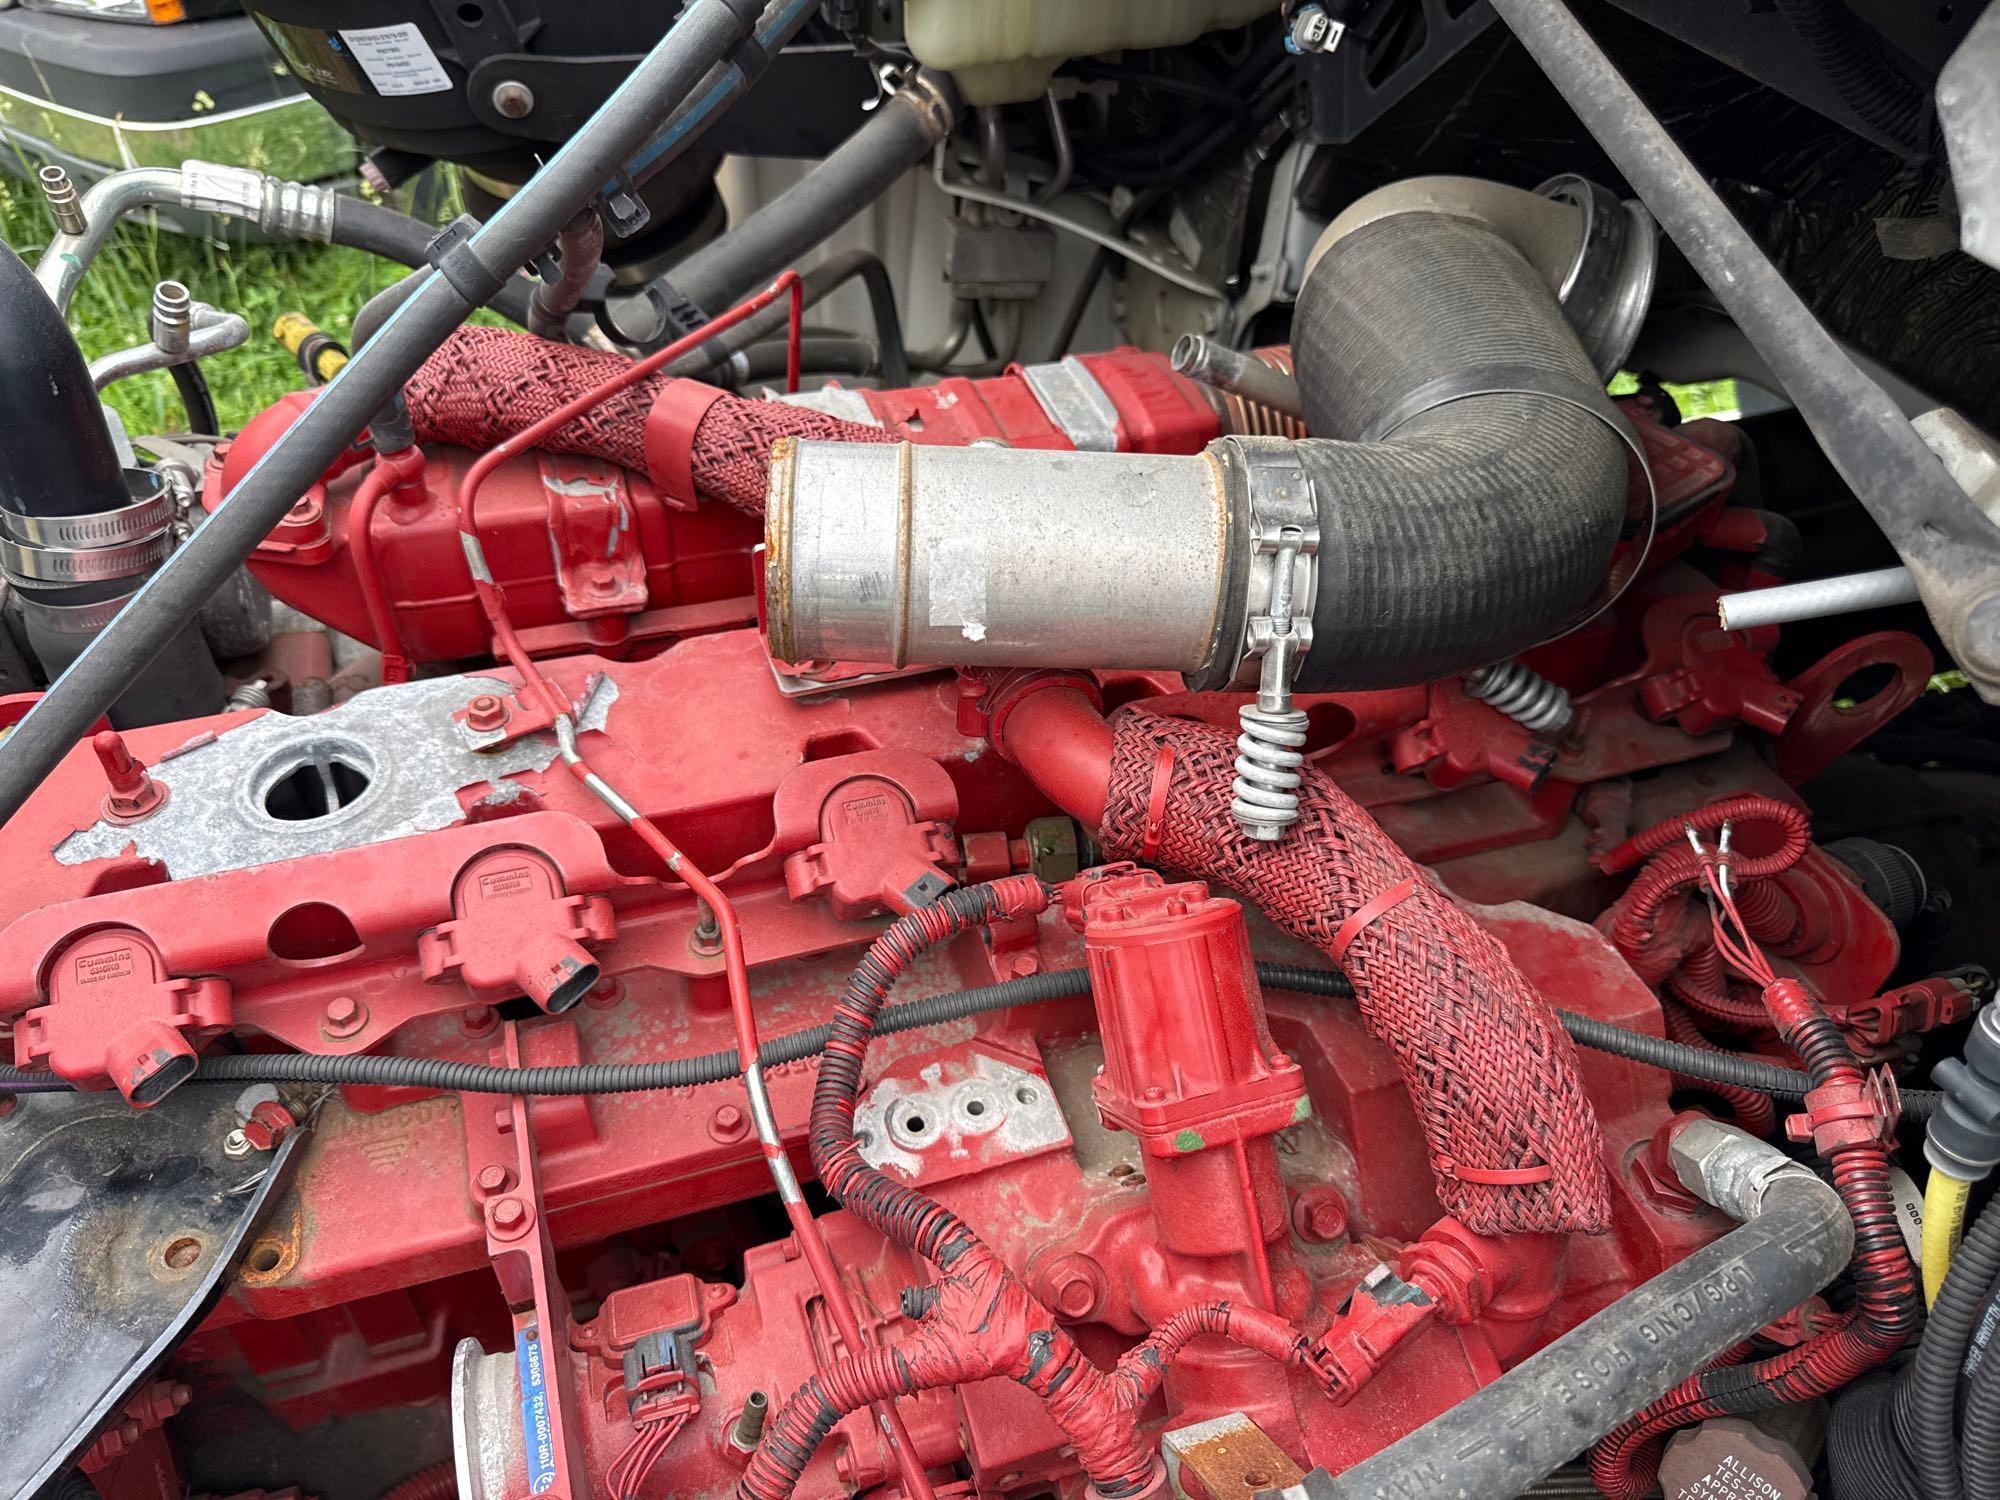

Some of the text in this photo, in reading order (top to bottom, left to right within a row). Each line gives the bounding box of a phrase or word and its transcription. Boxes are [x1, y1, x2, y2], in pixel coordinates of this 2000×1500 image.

[846, 798, 886, 811] Cummins
[482, 871, 530, 885] Cummins
[79, 953, 131, 968] Cummins
[1638, 1259, 1755, 1345] LPG/CNG
[1551, 1343, 1631, 1403] HOSE
[1702, 1474, 1742, 1500] APPR
[1723, 1455, 1782, 1500] ALLISON
